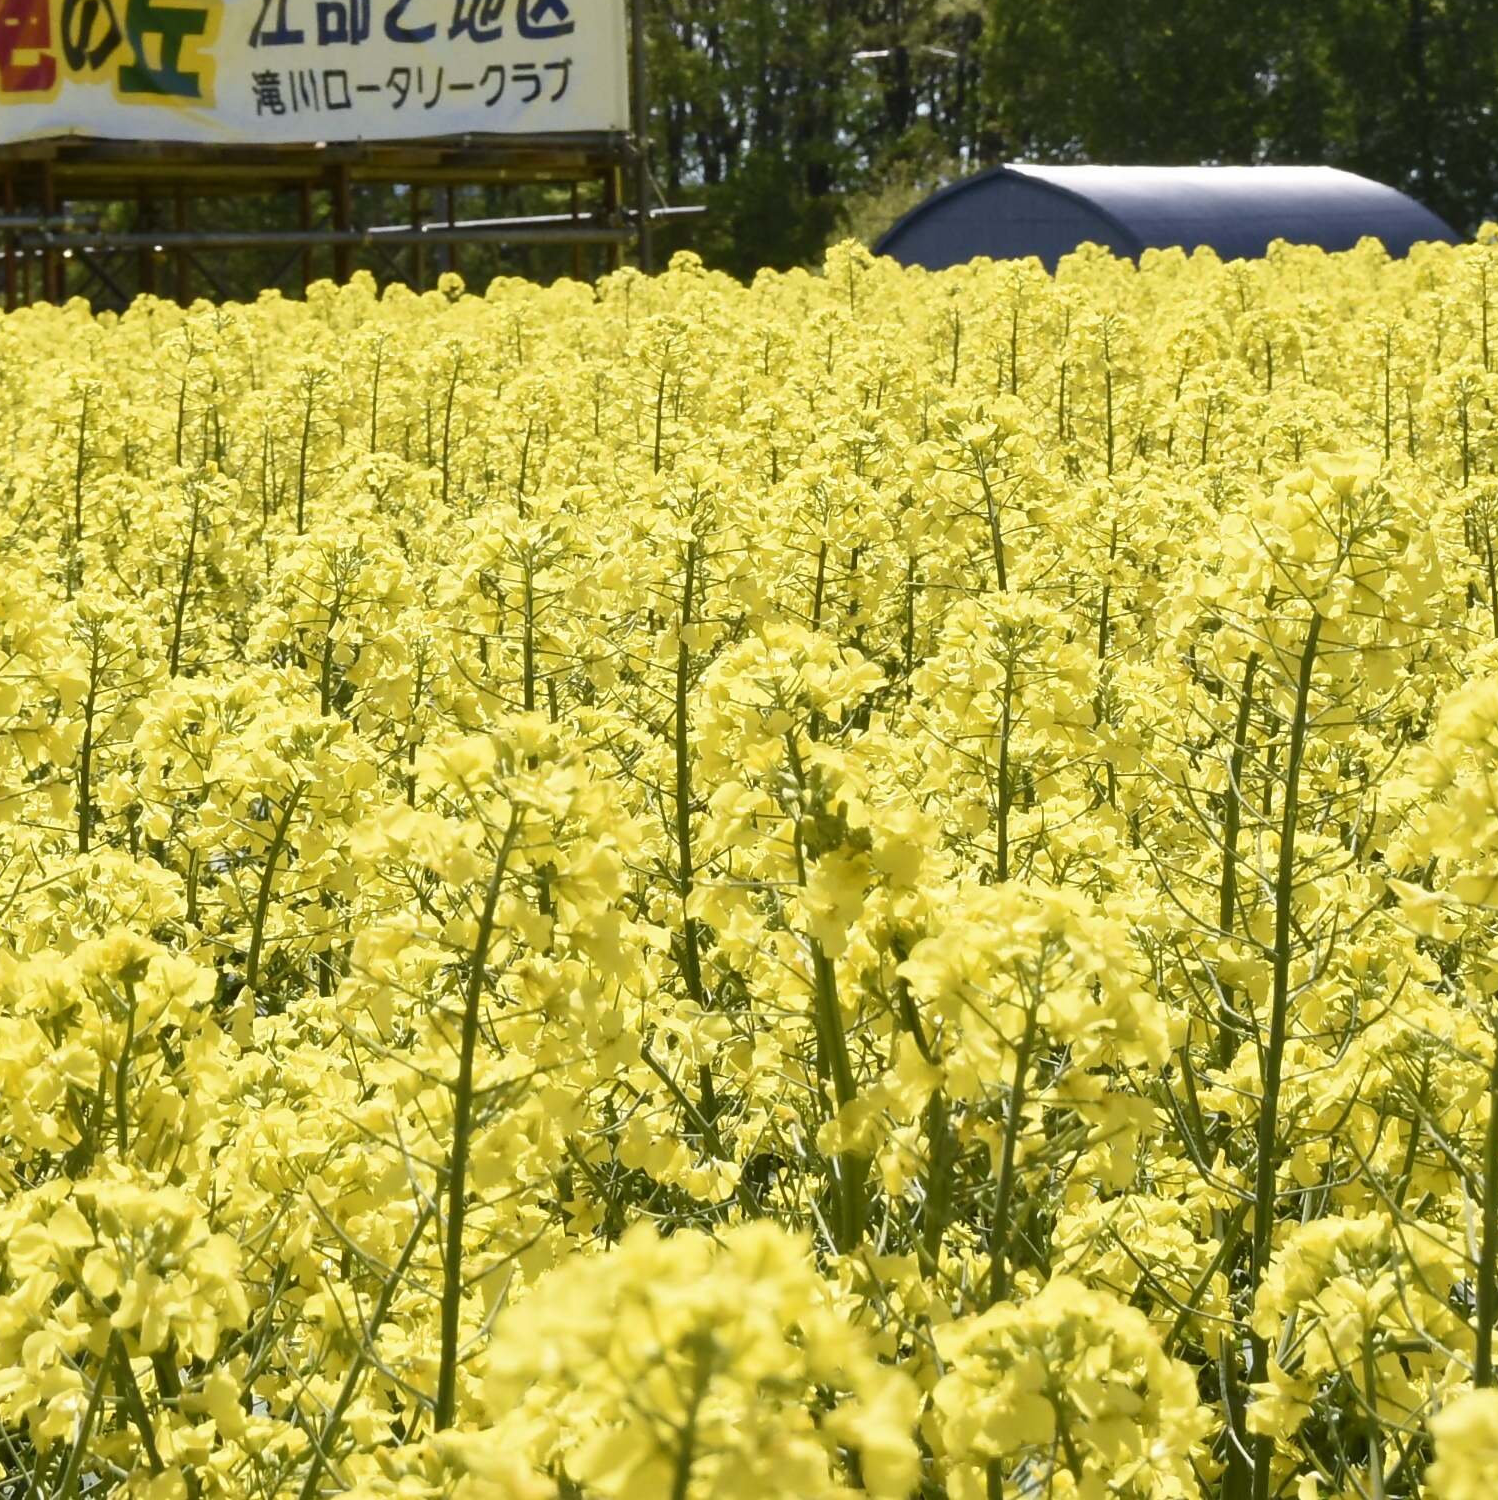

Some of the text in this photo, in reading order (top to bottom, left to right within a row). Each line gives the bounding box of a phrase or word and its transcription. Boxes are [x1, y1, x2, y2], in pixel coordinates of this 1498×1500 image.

[251, 57, 573, 116] 滝川ロータリークラブ
